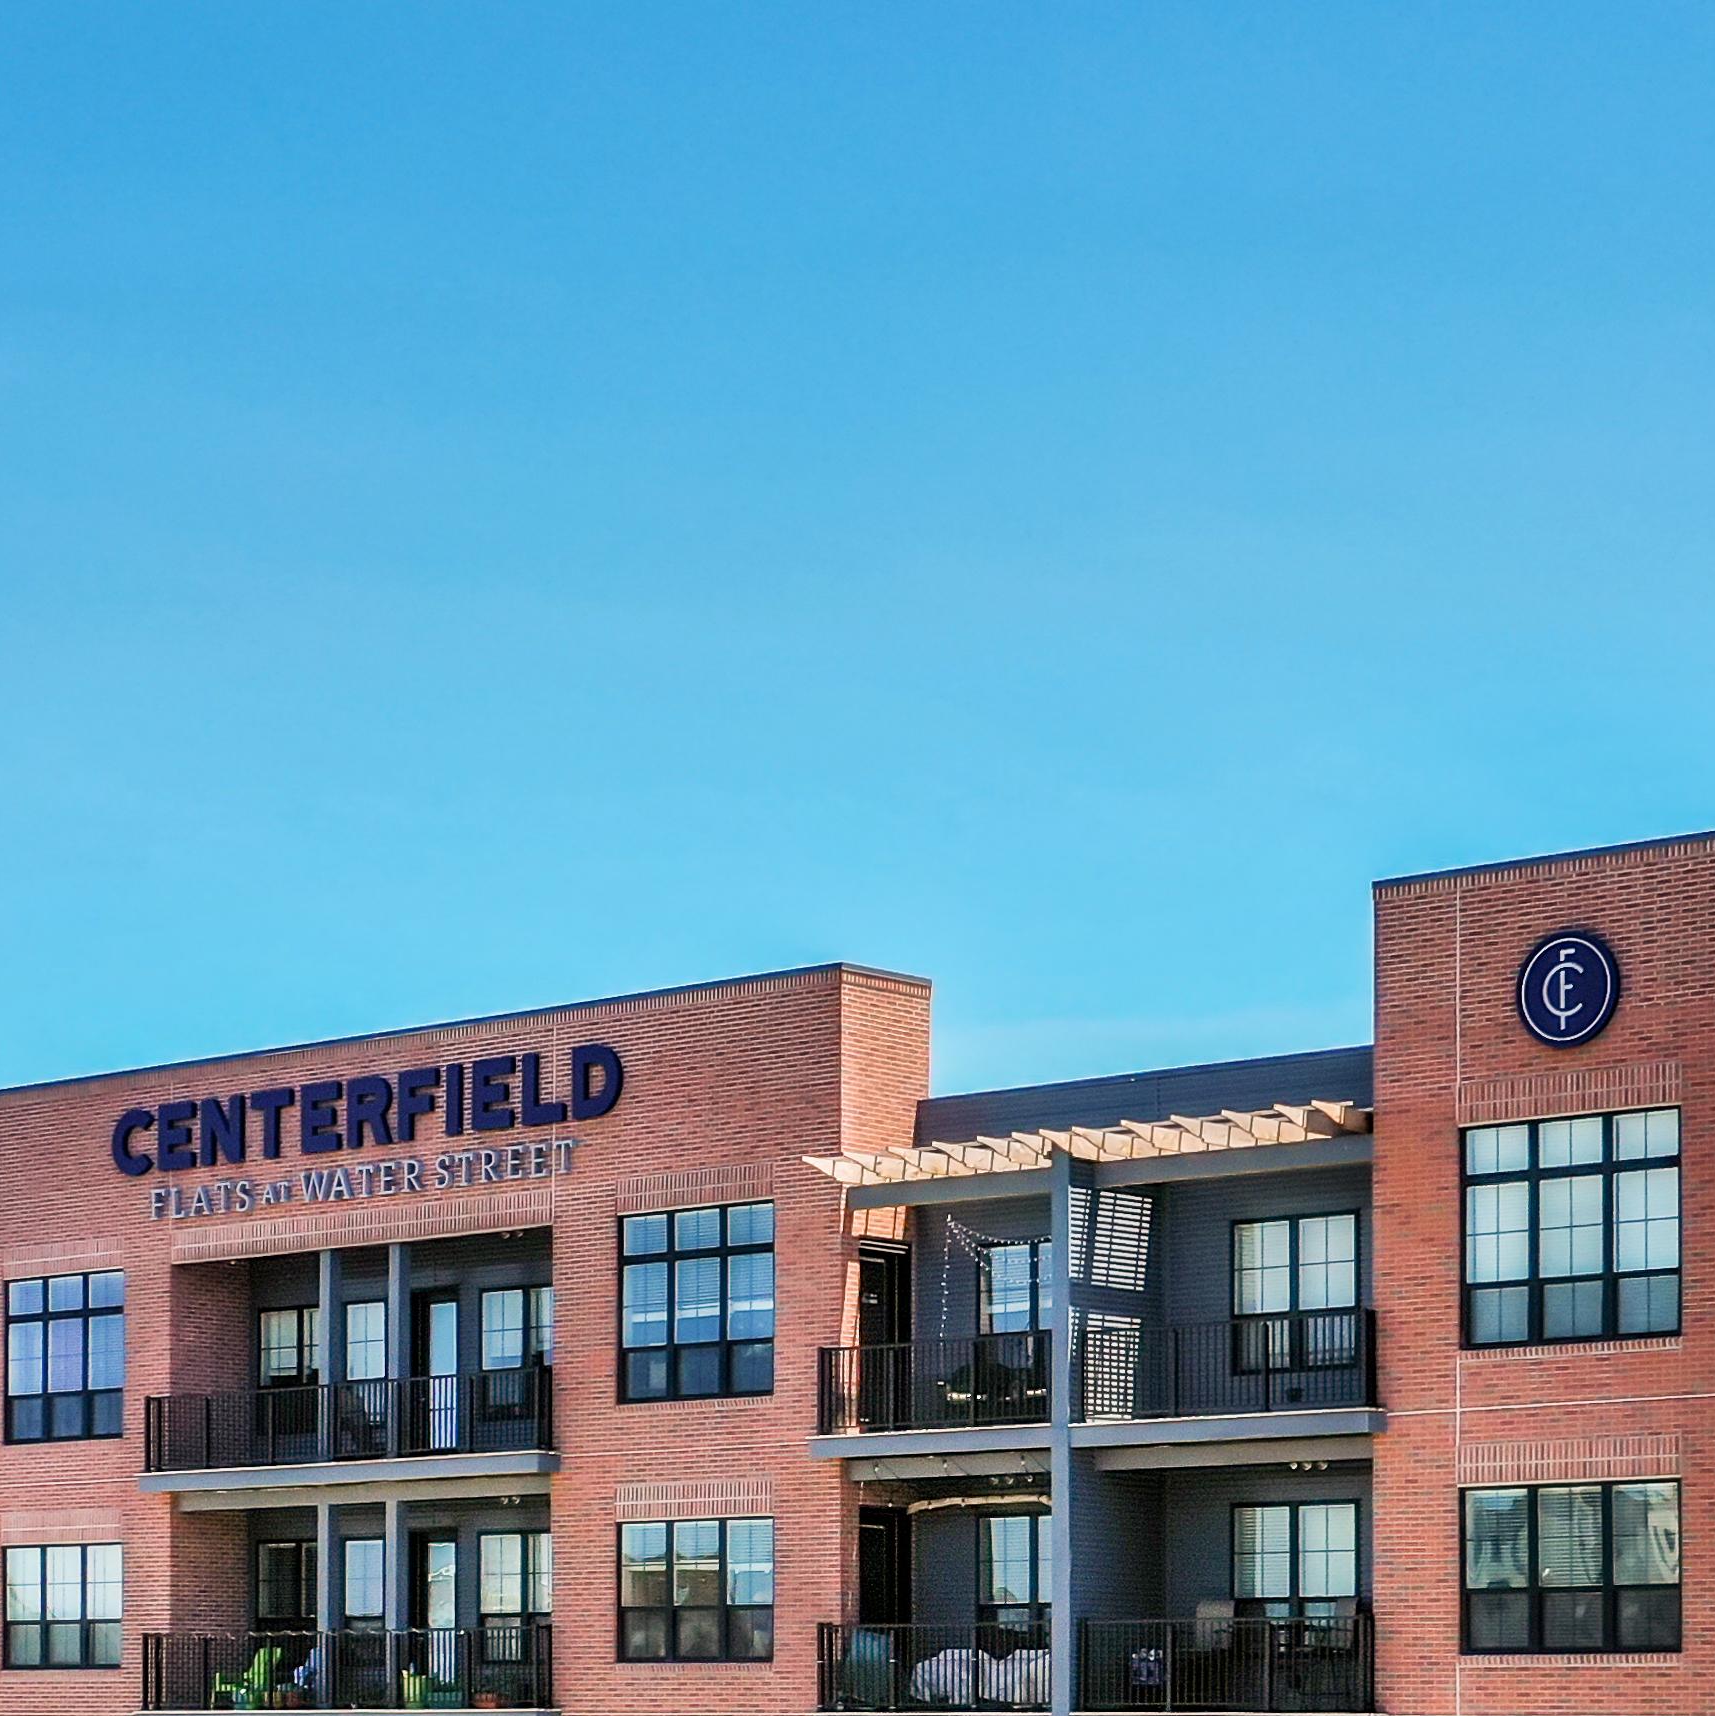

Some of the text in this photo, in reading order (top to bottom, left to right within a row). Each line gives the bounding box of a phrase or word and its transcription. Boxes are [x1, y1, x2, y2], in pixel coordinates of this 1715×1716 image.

[111, 1043, 624, 1177] CENTERFIELD
[150, 1139, 573, 1220] FLATS AT WATER STREET
